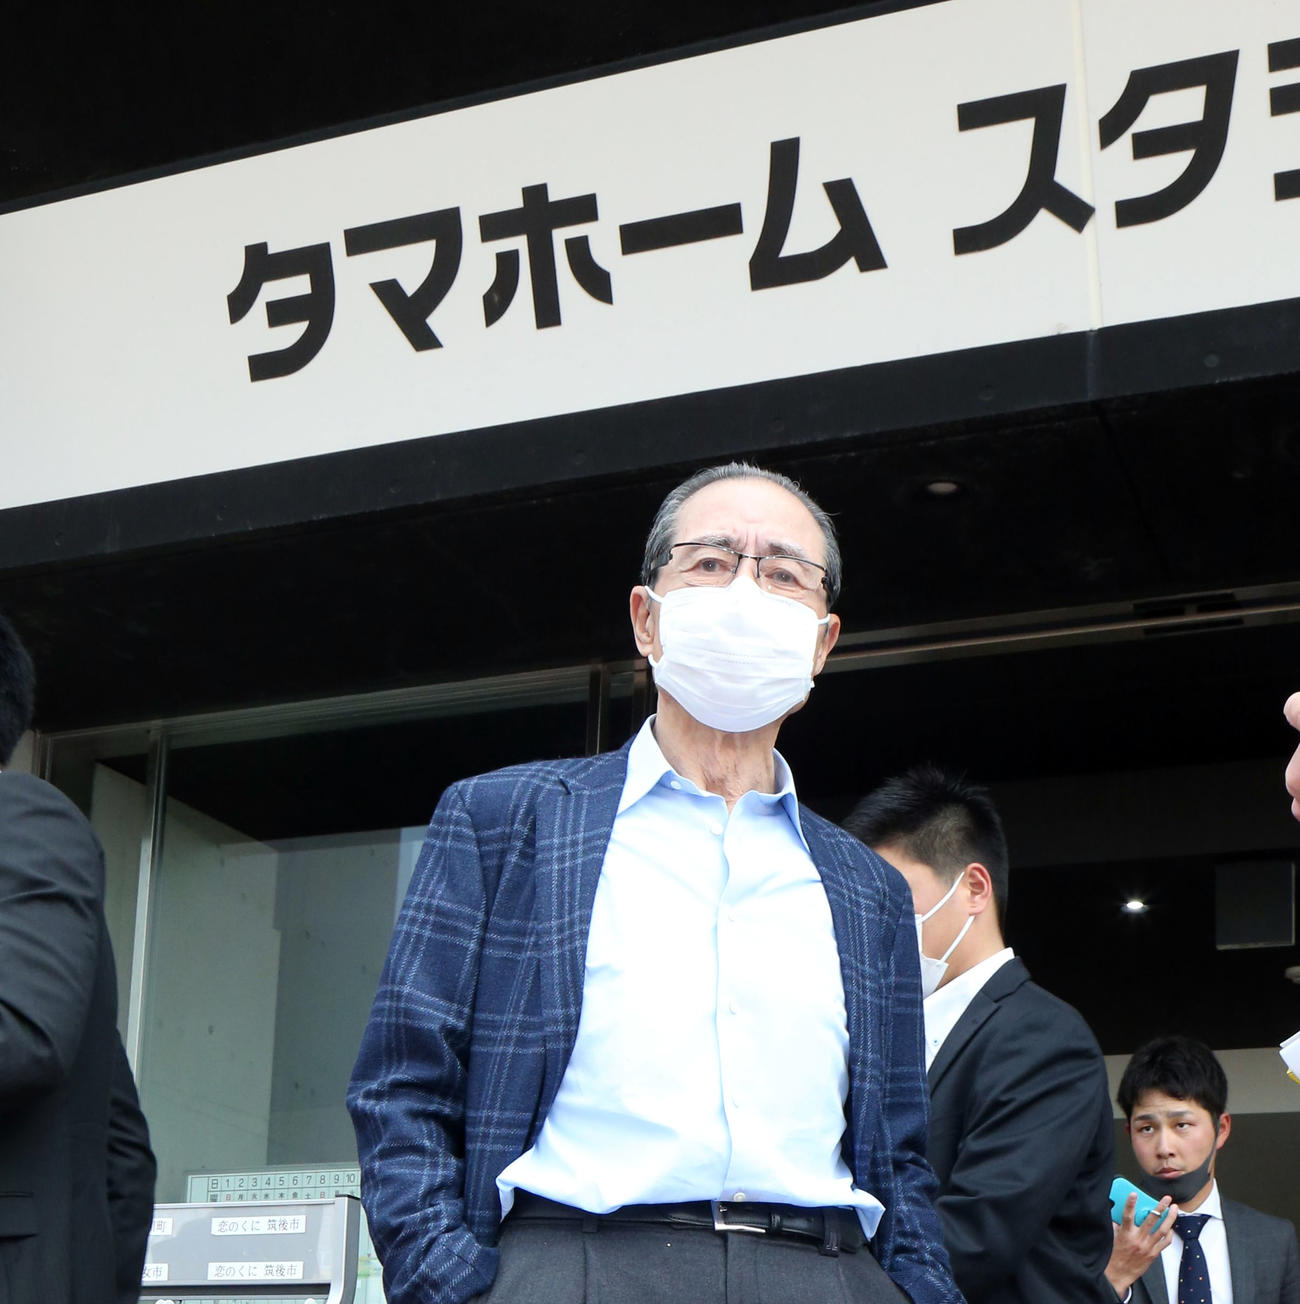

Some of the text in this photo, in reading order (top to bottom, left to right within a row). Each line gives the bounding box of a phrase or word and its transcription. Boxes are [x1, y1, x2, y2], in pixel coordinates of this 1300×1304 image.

[227, 137, 888, 382] タマホーム
[238, 1178, 244, 1187] 2
[251, 1177, 258, 1187] 3
[265, 1177, 271, 1186] 4
[279, 1176, 285, 1186] 5
[292, 1175, 298, 1185] 6
[306, 1175, 312, 1185] 7
[319, 1175, 326, 1184] 8
[333, 1174, 340, 1184] 9
[345, 1173, 355, 1183] 10
[217, 1217, 300, 1233] 恋のくに 筑後市
[214, 1263, 297, 1278] 恋のくに 筑後市
